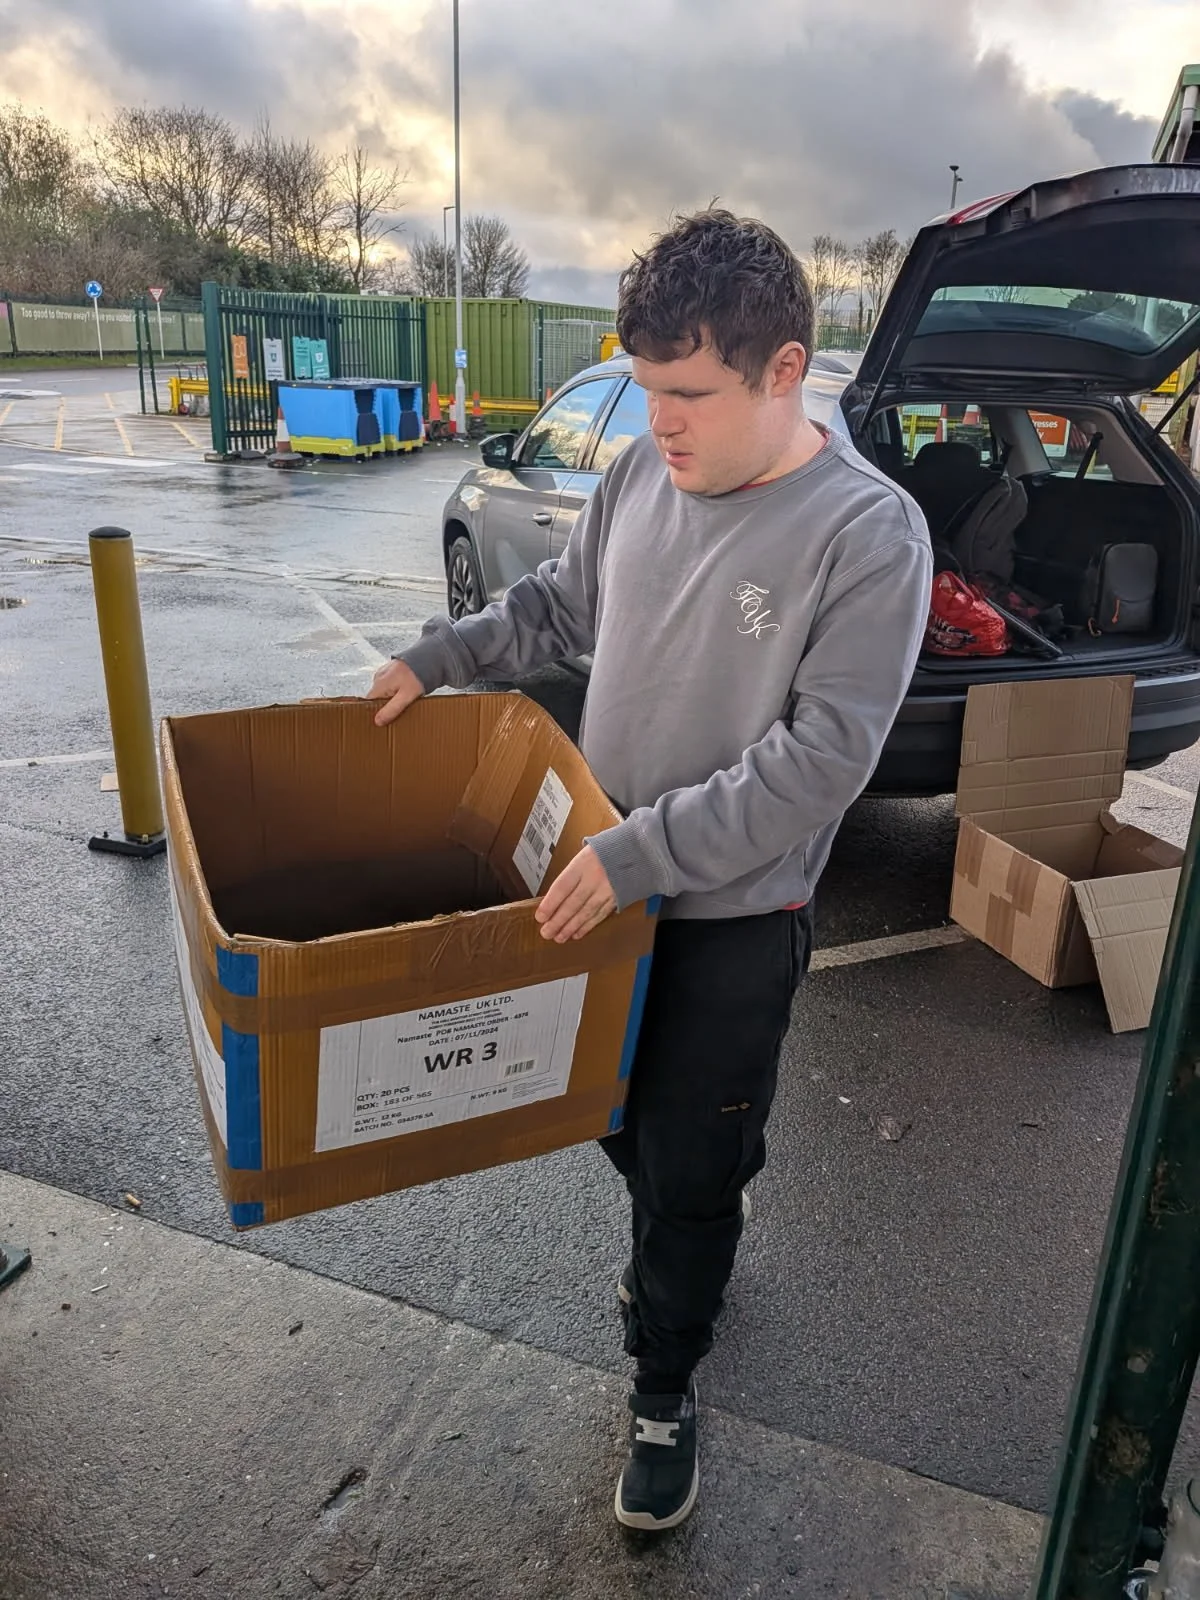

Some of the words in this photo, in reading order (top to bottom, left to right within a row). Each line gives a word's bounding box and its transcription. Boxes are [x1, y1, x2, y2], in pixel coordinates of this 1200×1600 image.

[21, 307, 33, 318] Too
[33, 307, 48, 321] good
[49, 308, 56, 319] to
[56, 309, 72, 320] throw
[418, 1004, 471, 1021] NAMASTE
[476, 1000, 491, 1010] UK
[493, 995, 514, 1006] LTD.
[397, 1032, 433, 1044] Namaste
[453, 1021, 486, 1033] NAMASTE
[487, 1016, 509, 1026] ORDER
[429, 1037, 449, 1046] DATE
[455, 1027, 499, 1041] 07/11/2024
[424, 1047, 473, 1073] WR
[482, 1041, 498, 1061] 3
[357, 1092, 379, 1102] QTY:
[381, 1089, 392, 1097] 20
[394, 1085, 411, 1094] PCS
[356, 1102, 379, 1111] BOX:
[402, 1094, 414, 1102] OF
[354, 1124, 379, 1133] BATCH
[355, 1117, 378, 1126] G.WT.
